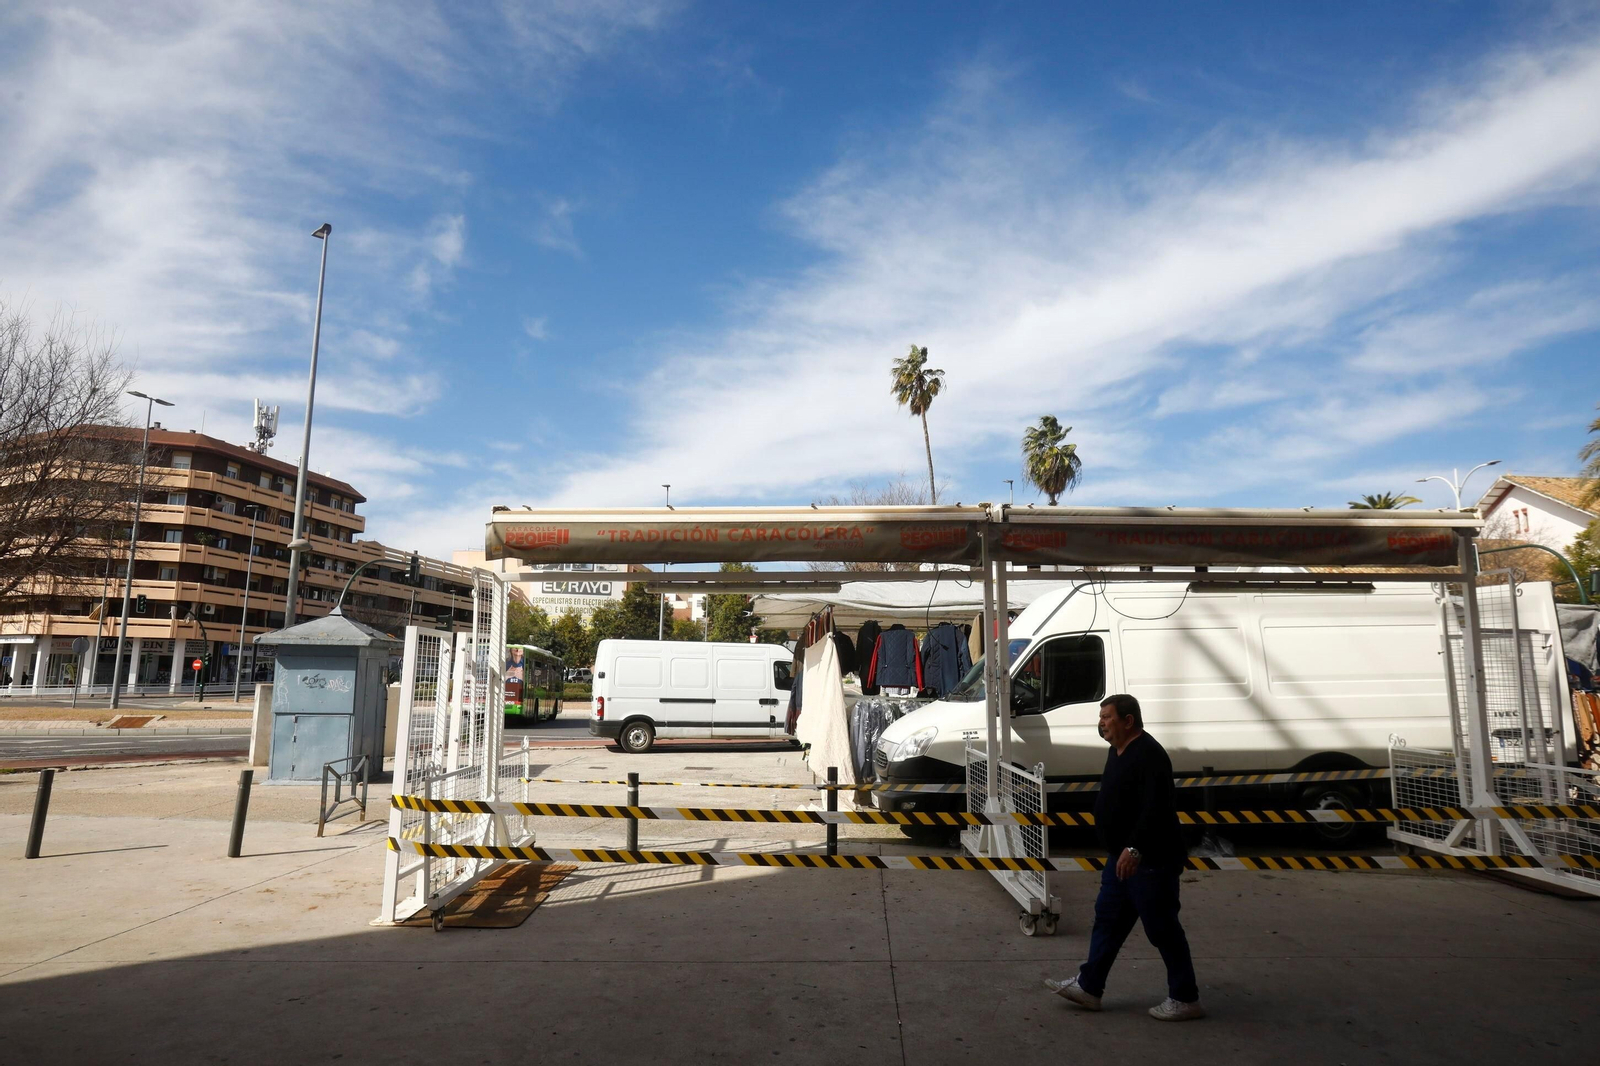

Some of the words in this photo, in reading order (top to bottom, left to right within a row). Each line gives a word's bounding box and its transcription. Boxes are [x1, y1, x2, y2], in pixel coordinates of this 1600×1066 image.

[543, 582, 561, 592] EL
[568, 581, 612, 594] RAYO
[533, 597, 573, 606] ESPECIALISTAS
